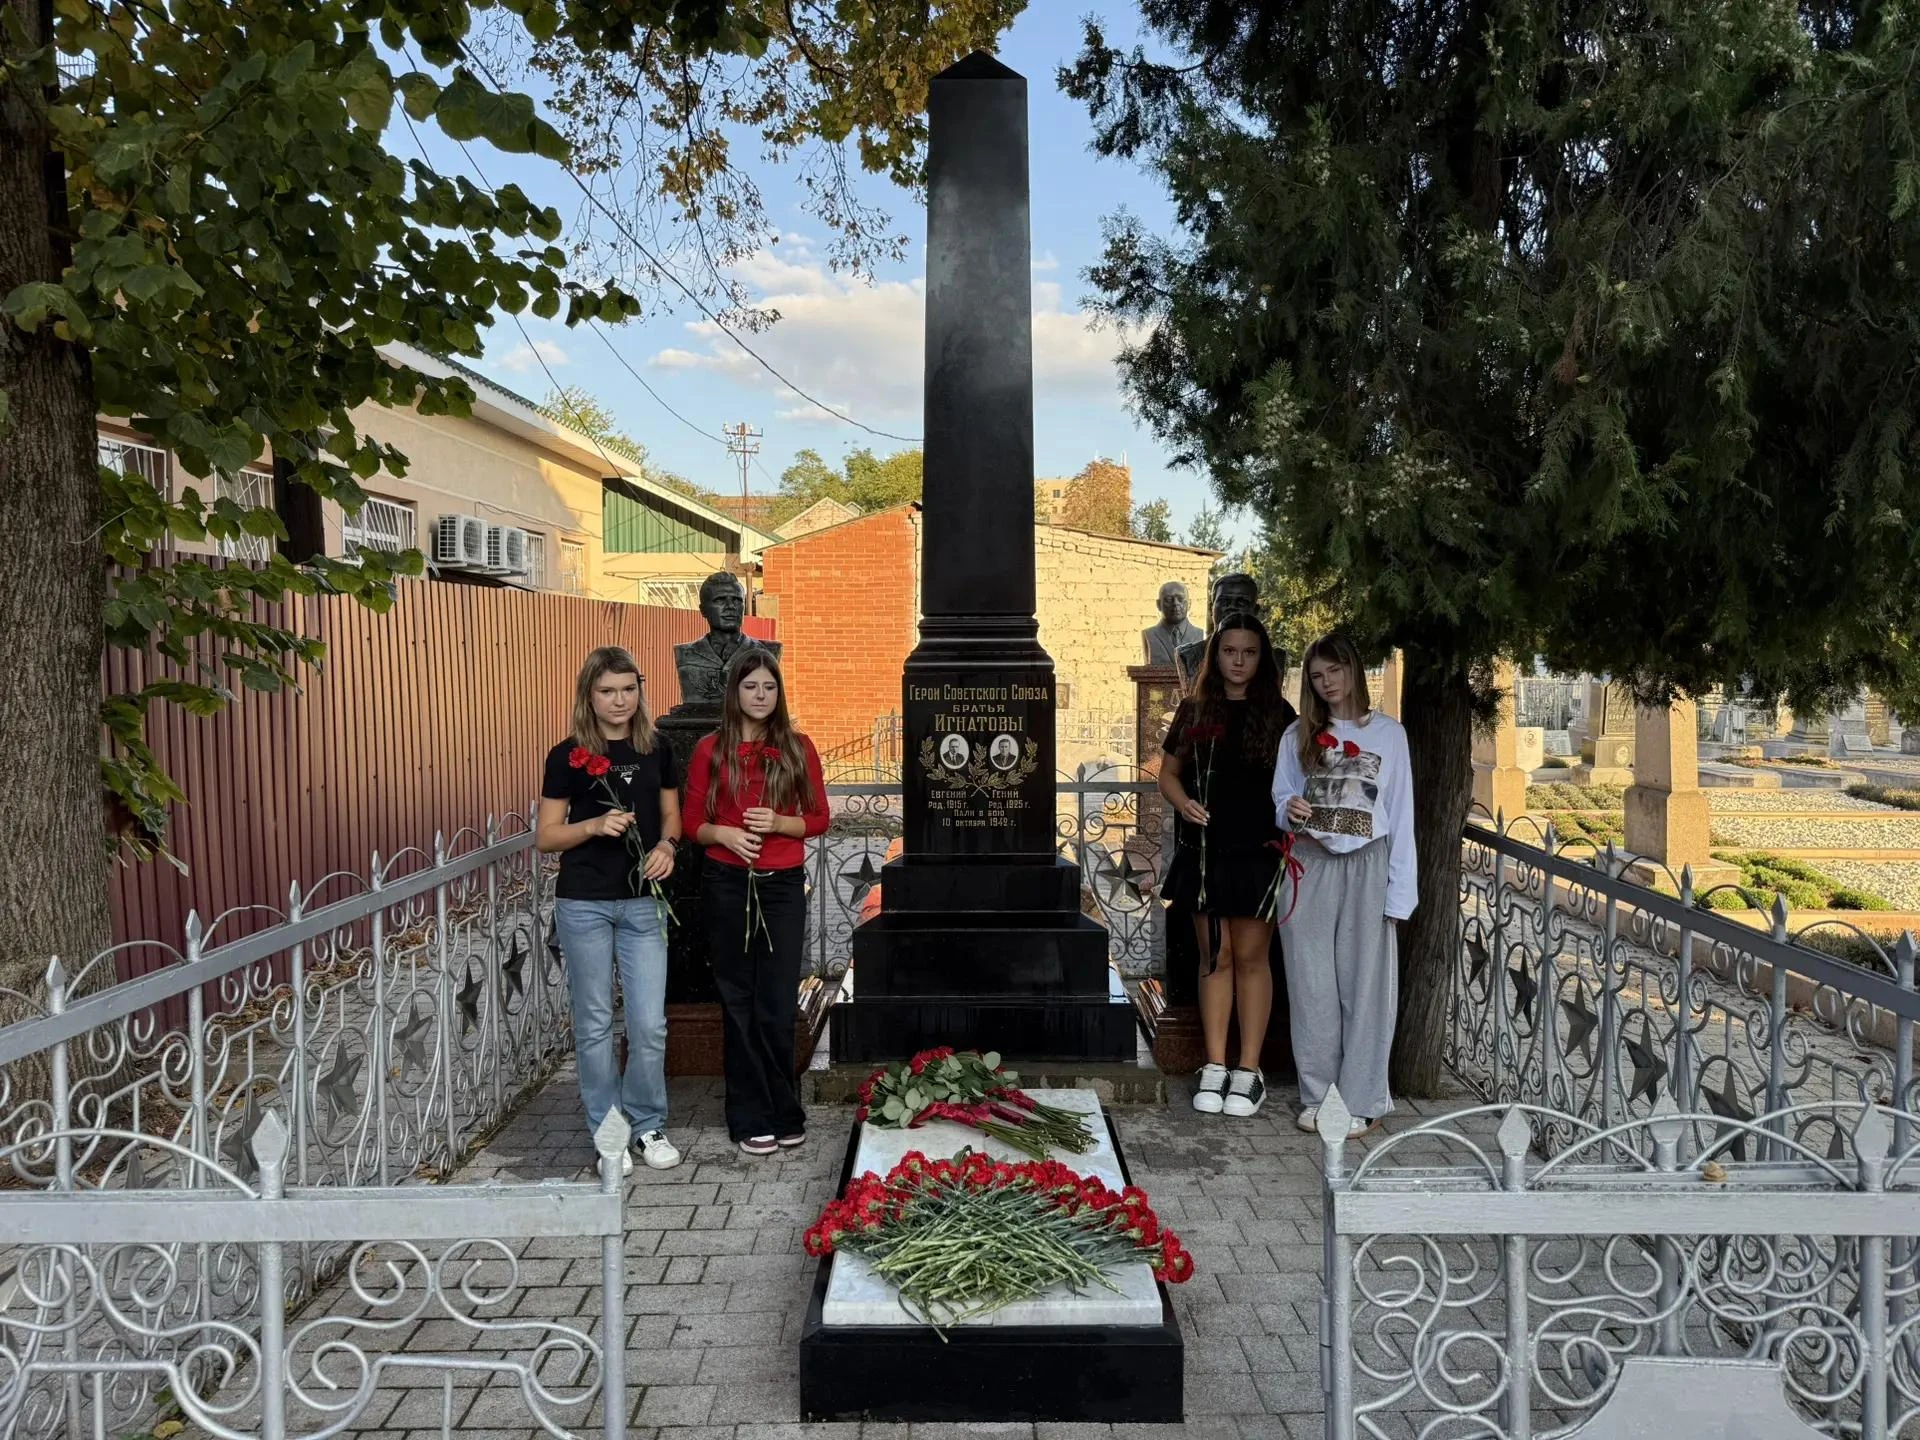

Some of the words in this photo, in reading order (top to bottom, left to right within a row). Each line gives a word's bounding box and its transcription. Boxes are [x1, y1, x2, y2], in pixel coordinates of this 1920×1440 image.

[952, 704, 1005, 713] БРАТЬЯ
[610, 763, 640, 772] GUESS
[942, 818, 951, 827] 10
[989, 818, 1008, 827] 1942
